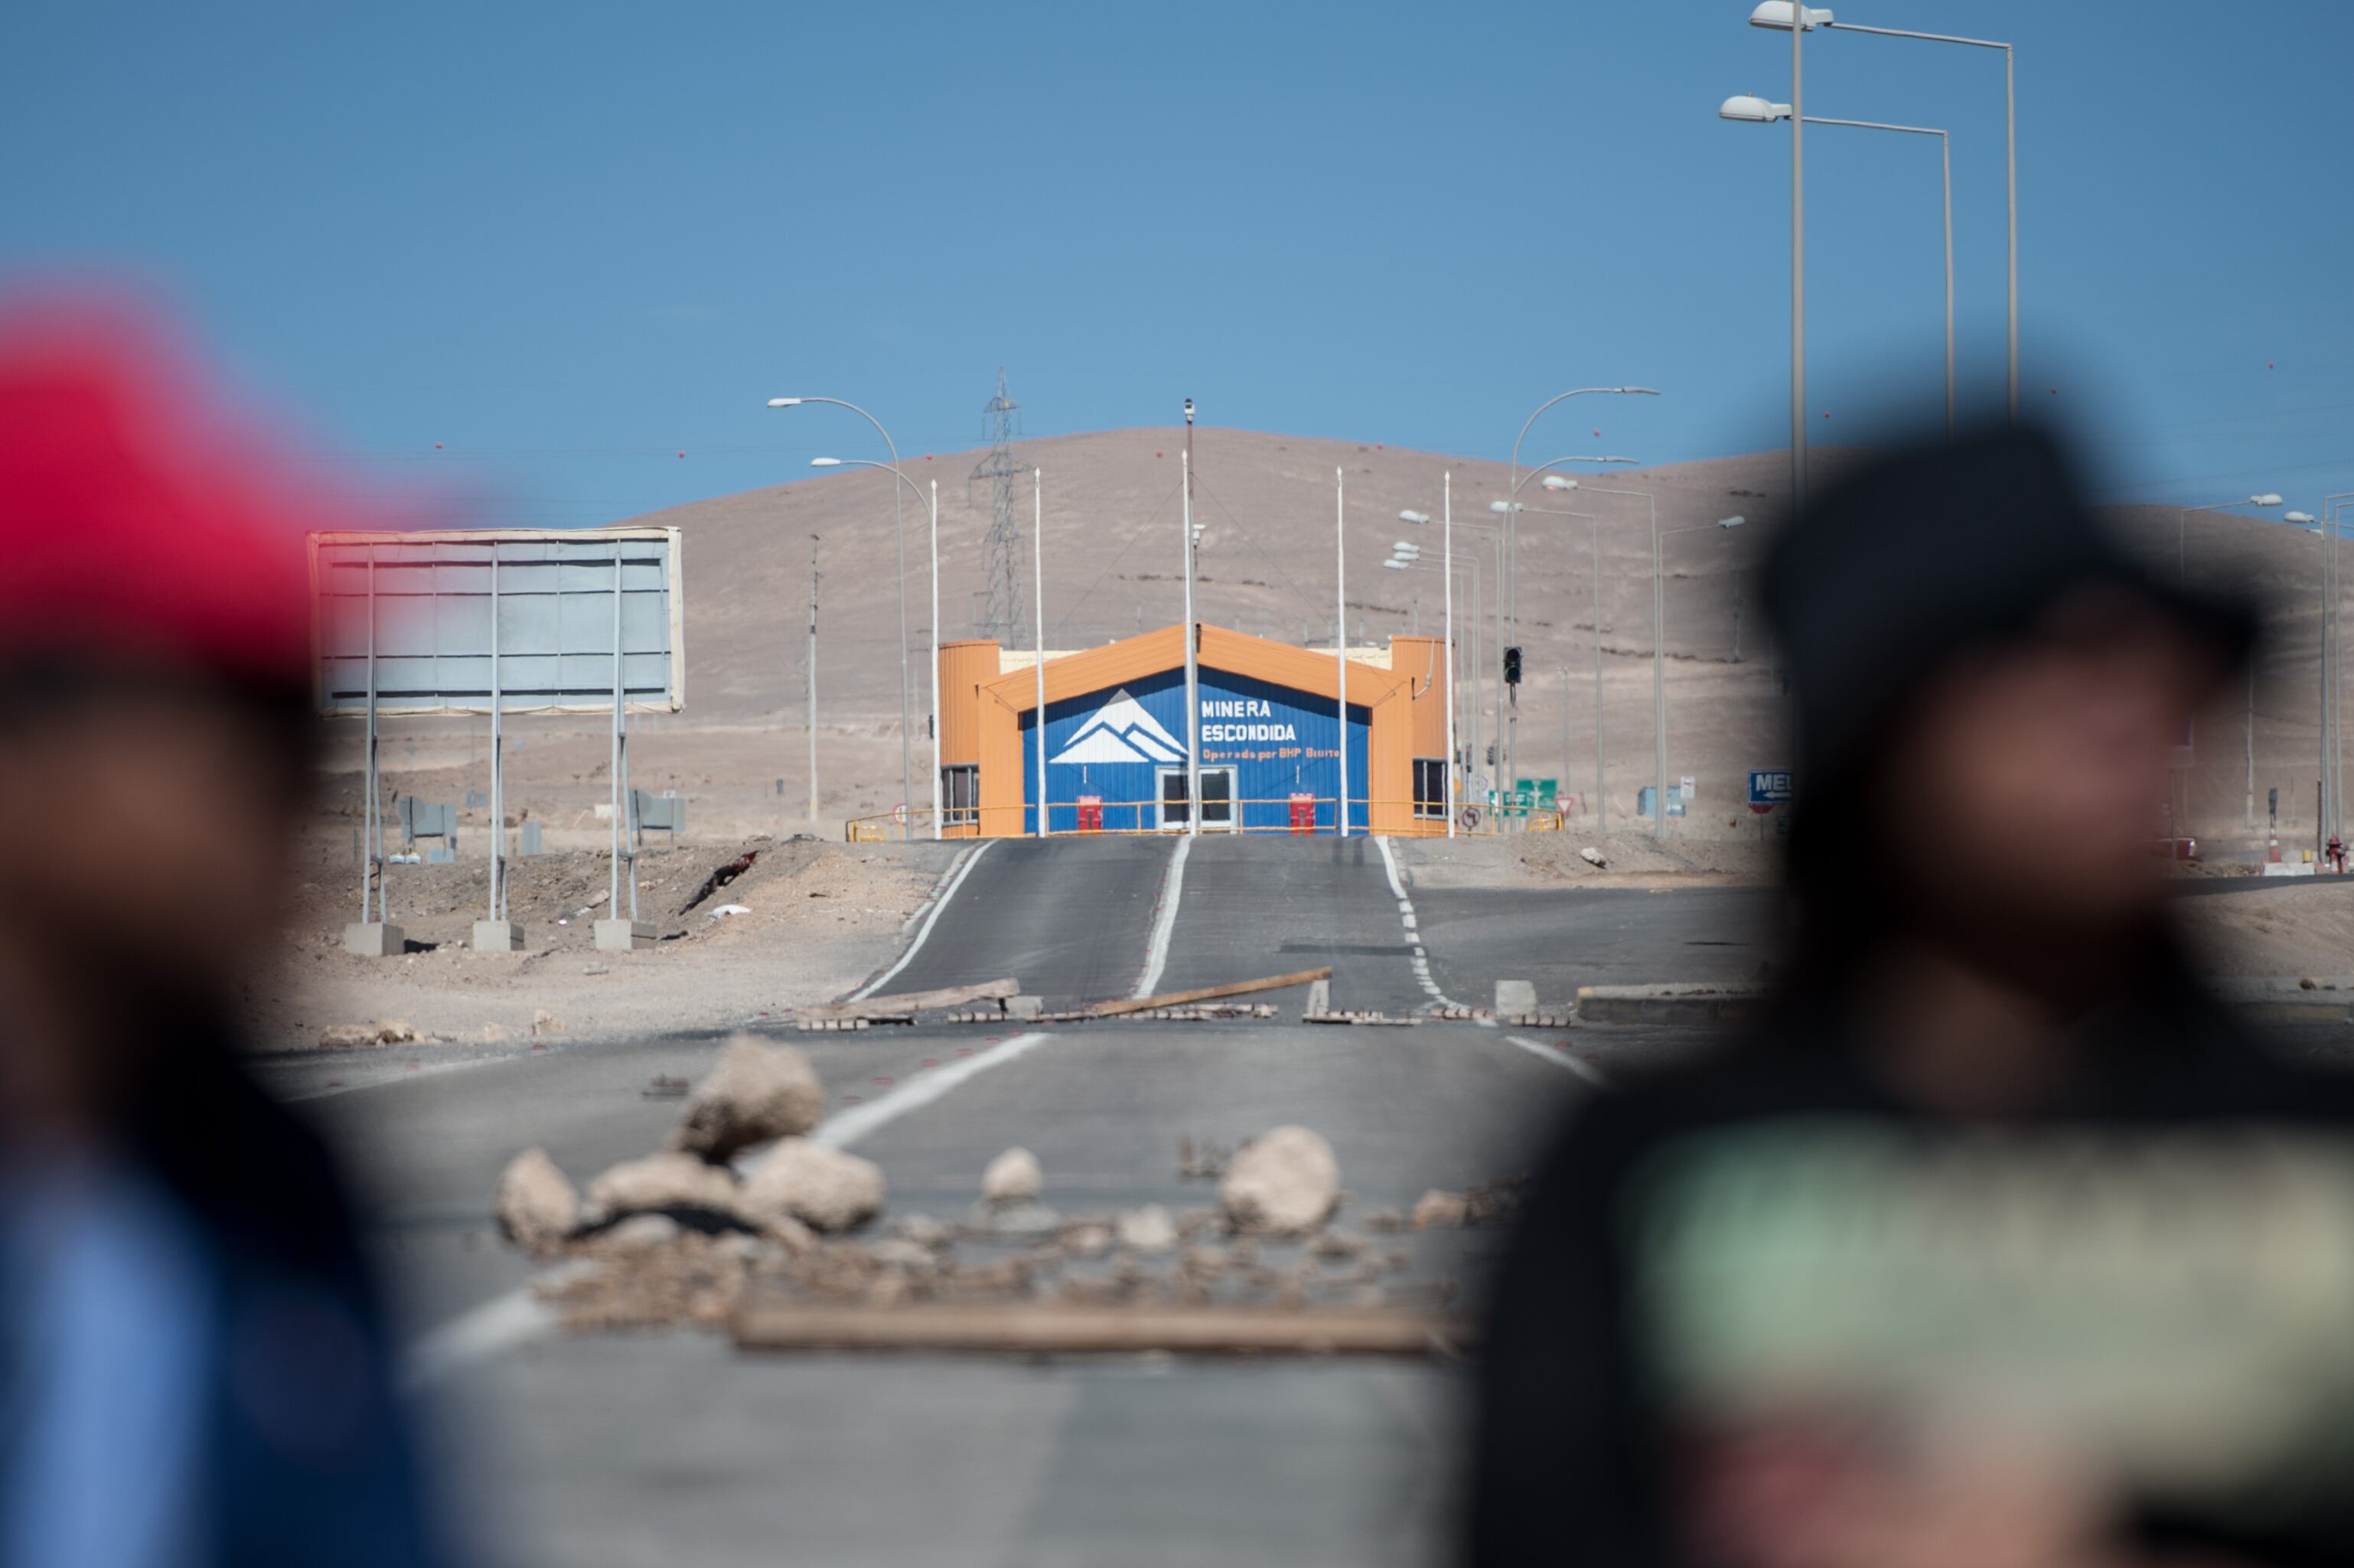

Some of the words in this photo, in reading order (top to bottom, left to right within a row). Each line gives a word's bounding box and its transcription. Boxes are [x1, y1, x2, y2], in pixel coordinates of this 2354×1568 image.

[1201, 700, 1271, 718] MINERA
[1201, 724, 1296, 742] ESCONDIDA
[1258, 751, 1277, 762] por
[1279, 747, 1301, 759] BHP
